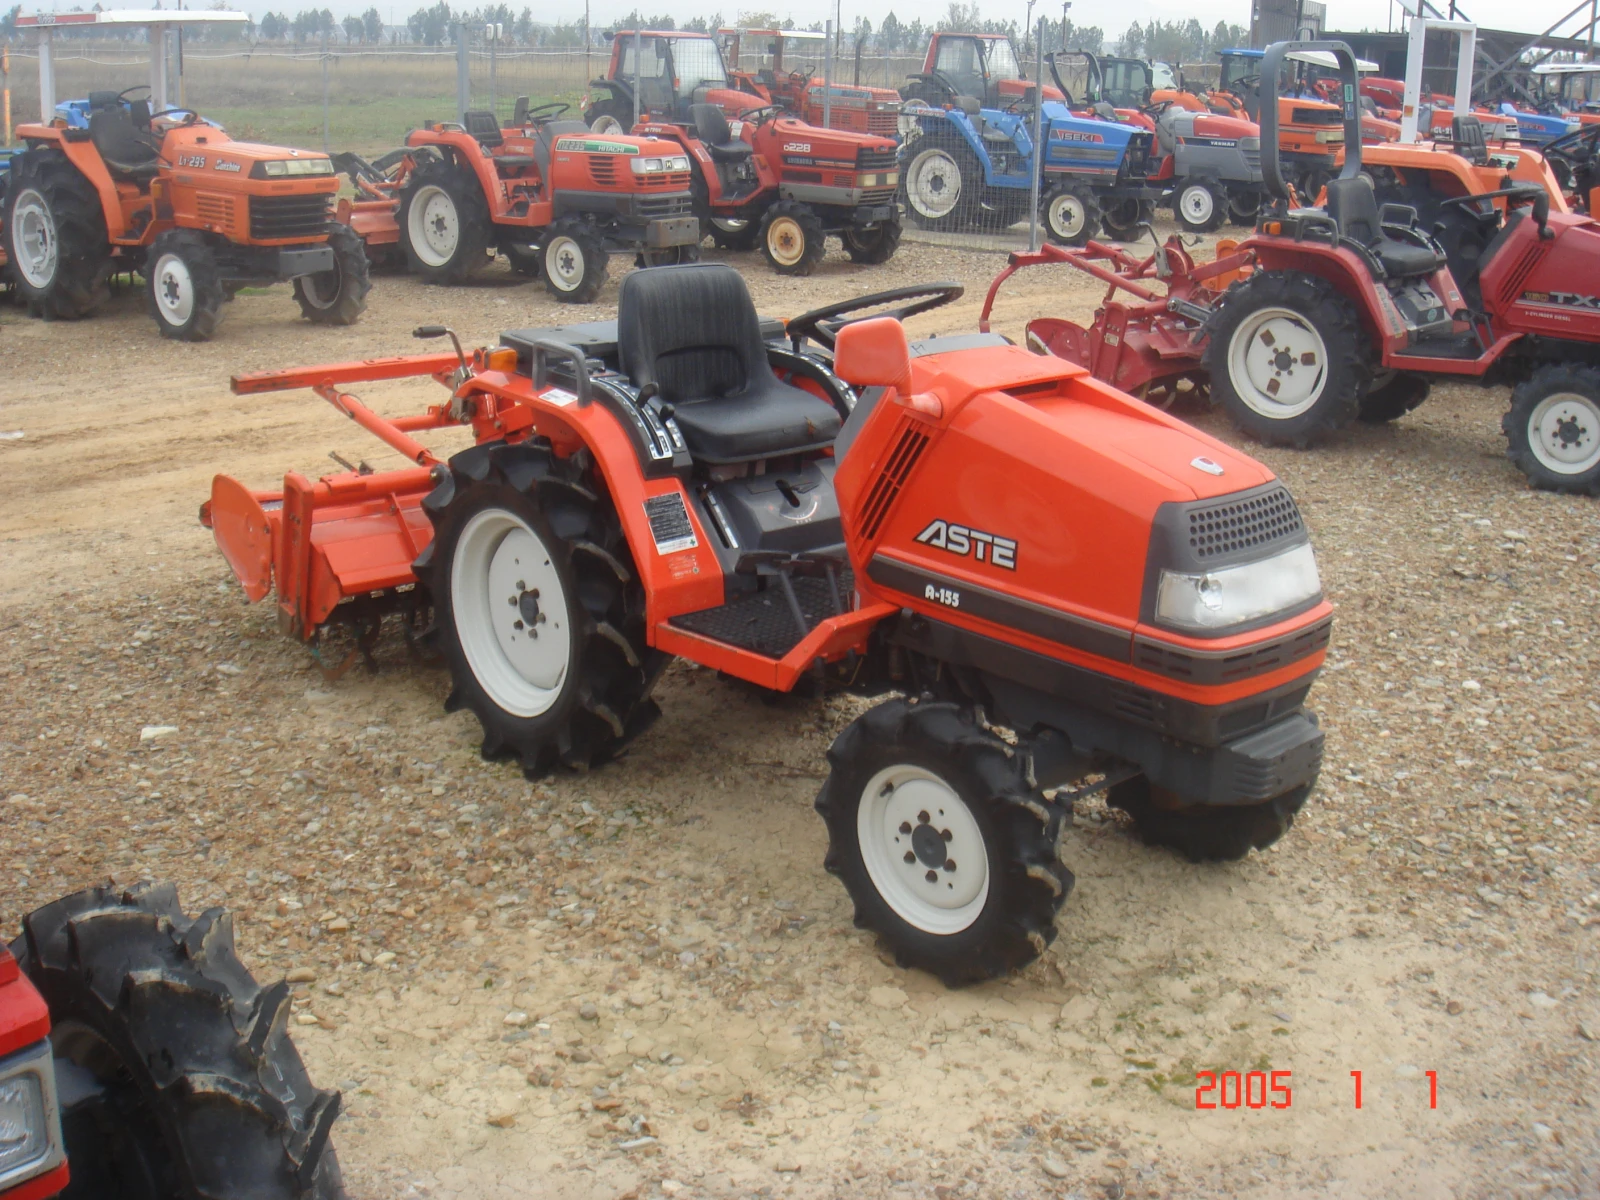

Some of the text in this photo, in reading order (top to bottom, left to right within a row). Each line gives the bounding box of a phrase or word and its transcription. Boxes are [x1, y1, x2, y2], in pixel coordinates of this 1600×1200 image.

[1061, 133, 1095, 142] ISEKI
[598, 145, 625, 153] HITACHI
[912, 518, 1018, 571] ASTE
[925, 584, 960, 607] A-155
